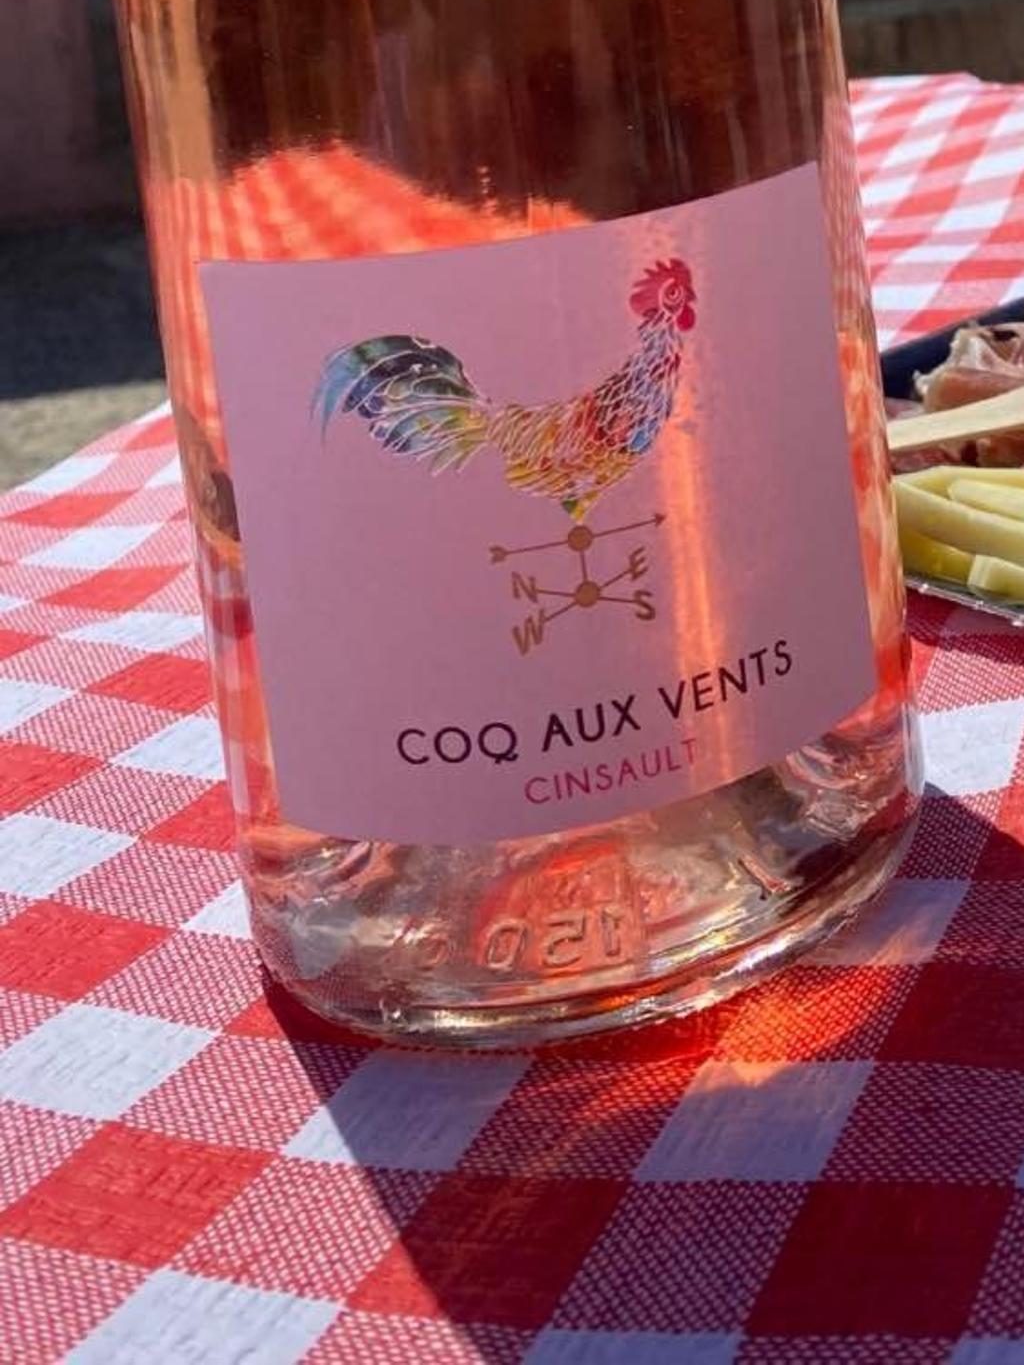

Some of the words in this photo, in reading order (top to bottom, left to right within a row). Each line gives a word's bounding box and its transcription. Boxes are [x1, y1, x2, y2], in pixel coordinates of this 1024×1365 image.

[629, 546, 649, 581] E
[511, 571, 538, 603] N
[633, 589, 656, 621] S
[512, 608, 546, 656] W
[397, 722, 518, 765] COQ
[542, 695, 641, 752] AUX
[658, 640, 793, 719] VENTS
[524, 738, 700, 805] CINSAULT
